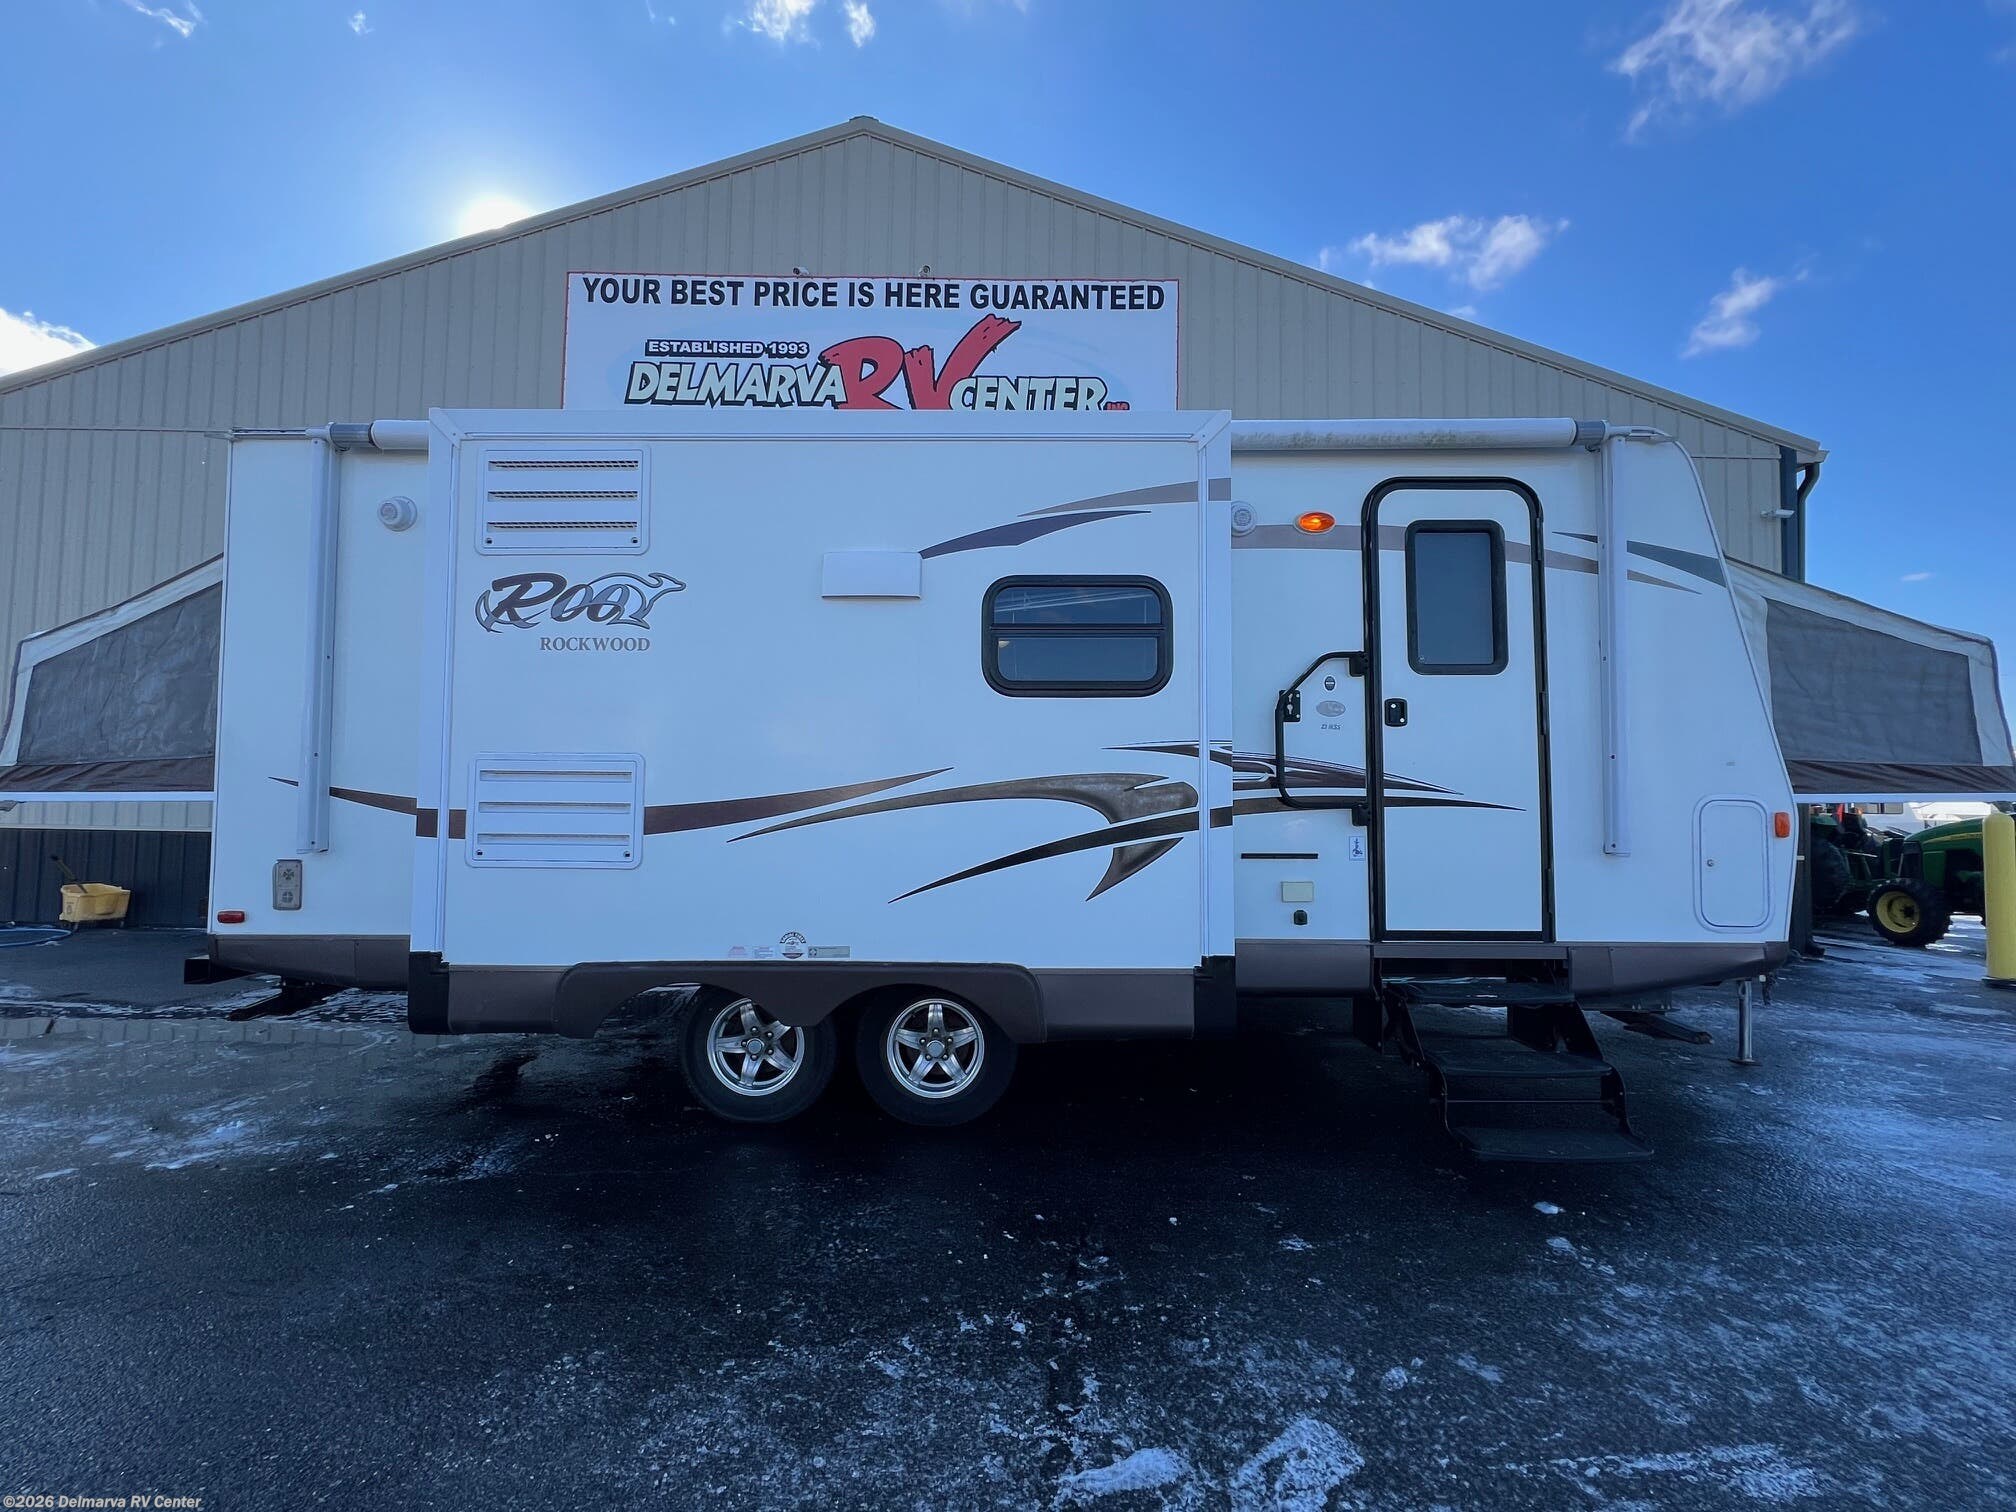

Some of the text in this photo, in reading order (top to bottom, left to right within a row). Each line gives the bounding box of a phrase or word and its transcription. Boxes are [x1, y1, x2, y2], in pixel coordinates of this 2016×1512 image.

[582, 277, 1165, 310] YOUR BEST PRICE IS HERE GUARANTEED
[646, 340, 809, 357] ESTABLISHED 1993
[625, 361, 848, 407] DELMARVA
[819, 313, 1023, 410] RV
[950, 375, 1108, 410] CENTER
[540, 637, 651, 652] ROCKWOOD
